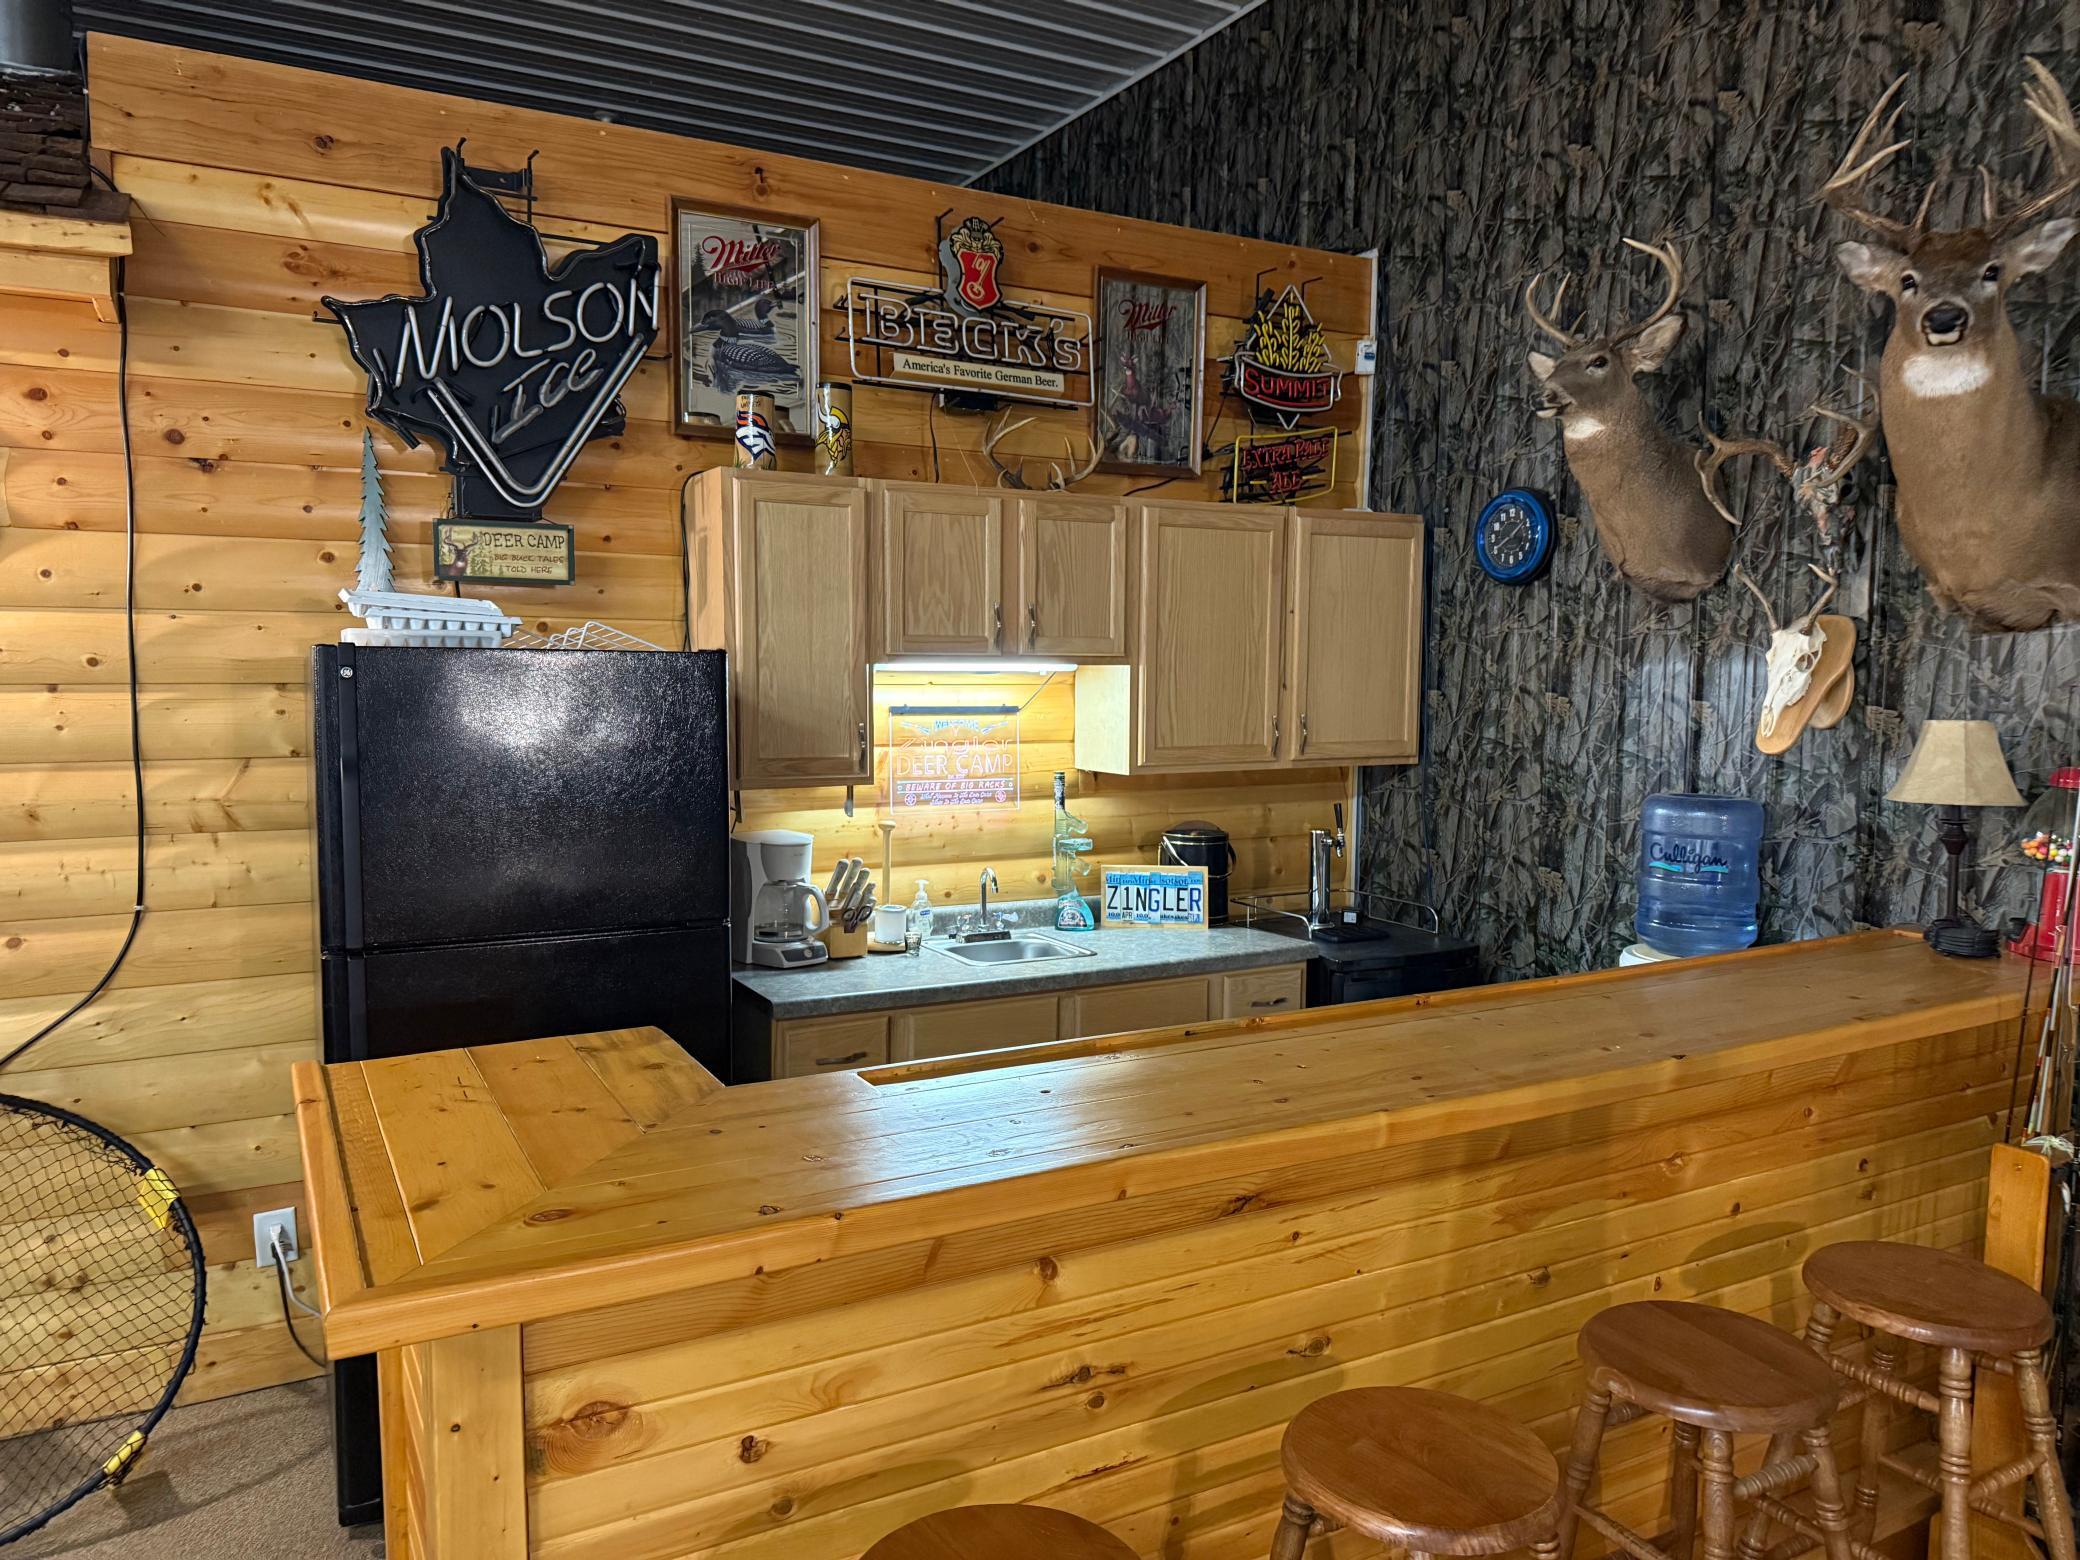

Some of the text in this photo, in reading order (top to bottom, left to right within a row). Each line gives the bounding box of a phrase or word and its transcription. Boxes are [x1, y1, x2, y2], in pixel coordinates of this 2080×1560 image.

[702, 236, 781, 272] Miller
[395, 264, 661, 389] MOLSON
[1118, 299, 1178, 331] Miller
[858, 293, 1082, 371] BECK'S
[902, 358, 1059, 388] America's Favorite German Beer.
[1244, 367, 1331, 399] SUMMIT
[1242, 438, 1330, 470] EXTRA PALE
[1269, 470, 1302, 496] ALE
[483, 531, 565, 549] DEER CAMP
[494, 553, 564, 564] BIG BUCK TALES
[505, 565, 553, 575] TOLD HERE
[896, 752, 1013, 775] DEER CAMP
[905, 779, 1006, 792] BEWARE OF BIG RACKS
[1650, 842, 1728, 874] Culligan
